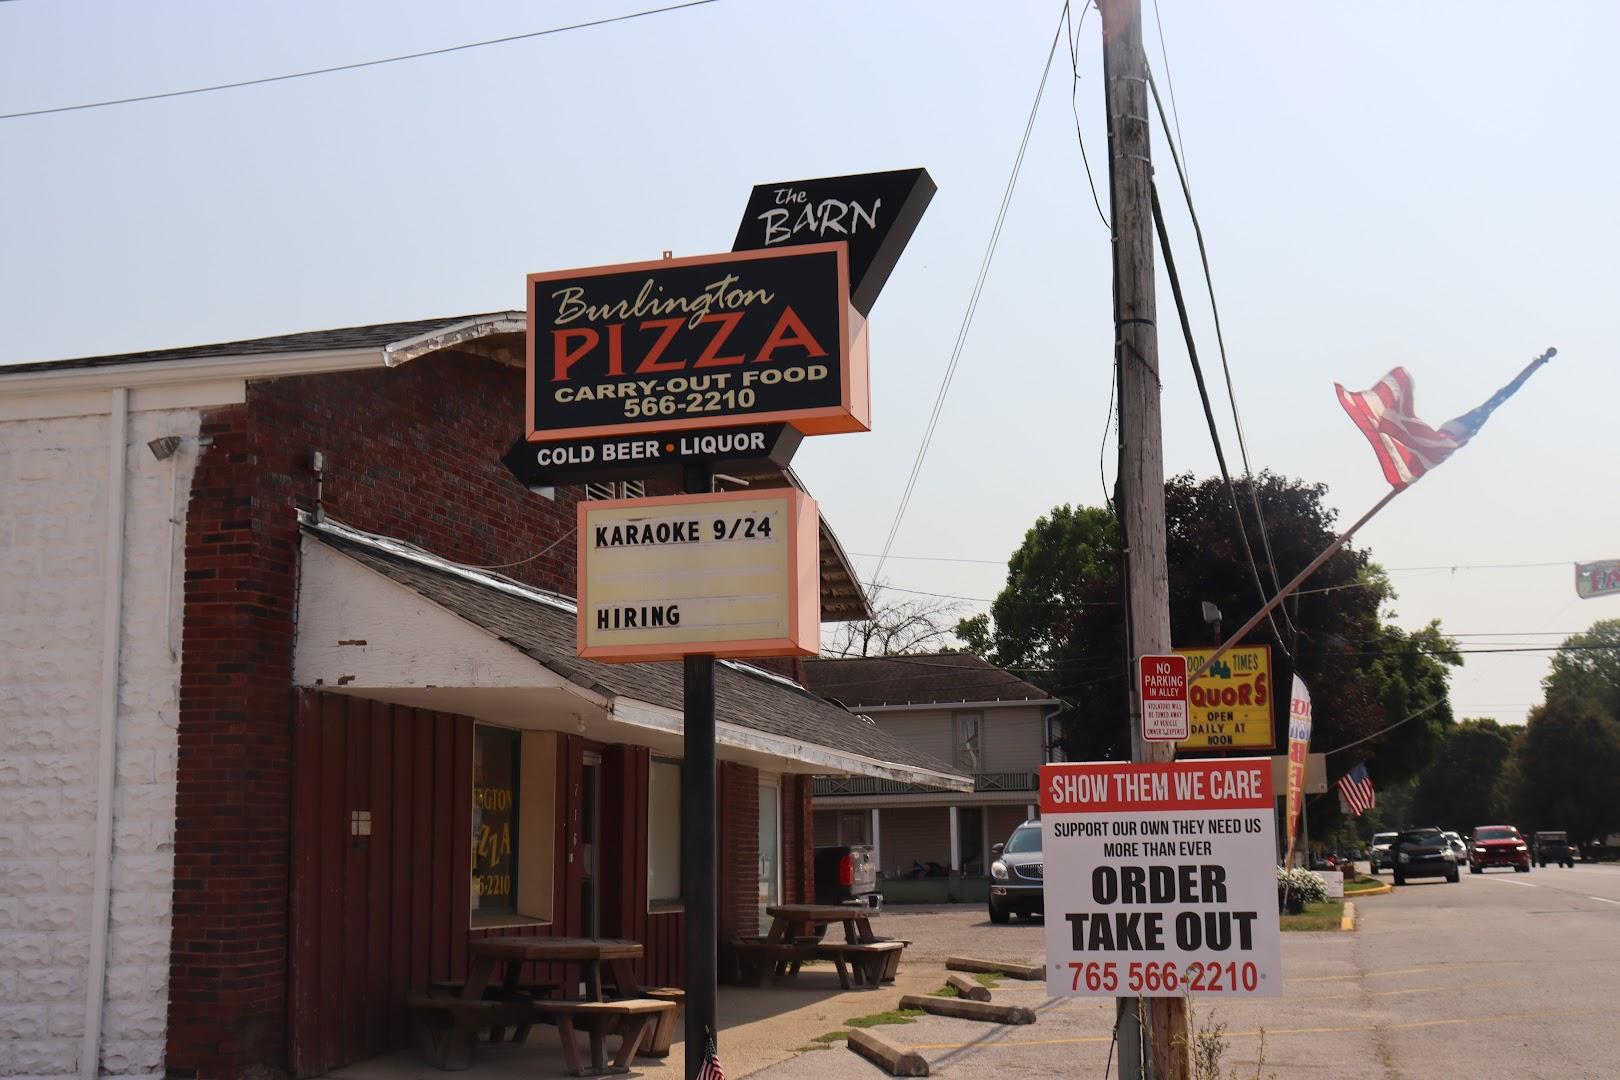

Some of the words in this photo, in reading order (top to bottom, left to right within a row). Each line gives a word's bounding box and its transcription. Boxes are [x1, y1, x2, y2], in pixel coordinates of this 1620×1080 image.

[773, 188, 807, 205] The
[758, 198, 881, 245] BARN
[551, 273, 774, 330] Burlington
[550, 304, 829, 382] PIZZA
[554, 373, 731, 403] CARRY-OUT
[742, 364, 828, 387] FOOD
[623, 388, 755, 418] 566-2210
[537, 443, 595, 467] COLD
[602, 440, 660, 462] BEER
[680, 432, 765, 456] LIQUOR
[595, 521, 700, 547] KARAOKE
[713, 516, 771, 540] 9/24
[597, 605, 680, 629] HIRING
[1156, 662, 1171, 674] NO
[1187, 656, 1205, 672] OOD
[1233, 654, 1258, 671] TIMES
[1144, 675, 1183, 687] PARKING
[1149, 687, 1157, 697] IN
[1159, 687, 1179, 697] ALLEY
[1190, 672, 1267, 708] QUORS
[1191, 723, 1224, 734] DAILY
[1234, 723, 1245, 733] AT
[1207, 711, 1233, 721] OPEN
[1207, 735, 1233, 745] NOON
[1052, 774, 1109, 804] SHOW
[1113, 772, 1169, 803] THEM
[1174, 771, 1204, 801] WE
[1210, 769, 1263, 800] CARE
[1054, 821, 1109, 837] SUPPORT
[1112, 820, 1137, 837] OUR
[1140, 820, 1169, 836] OWN
[1172, 819, 1205, 835] THEY
[1208, 818, 1241, 834] NEED
[1245, 818, 1262, 833] US
[1104, 842, 1139, 857] MORE
[1142, 841, 1176, 857] THAN
[1180, 841, 1212, 856] EVER
[1091, 864, 1228, 905] ORDER
[1065, 912, 1166, 952] TAKE
[1175, 911, 1258, 952] OUT
[1068, 961, 1119, 992] 765
[1128, 961, 1258, 992] 566-2210
